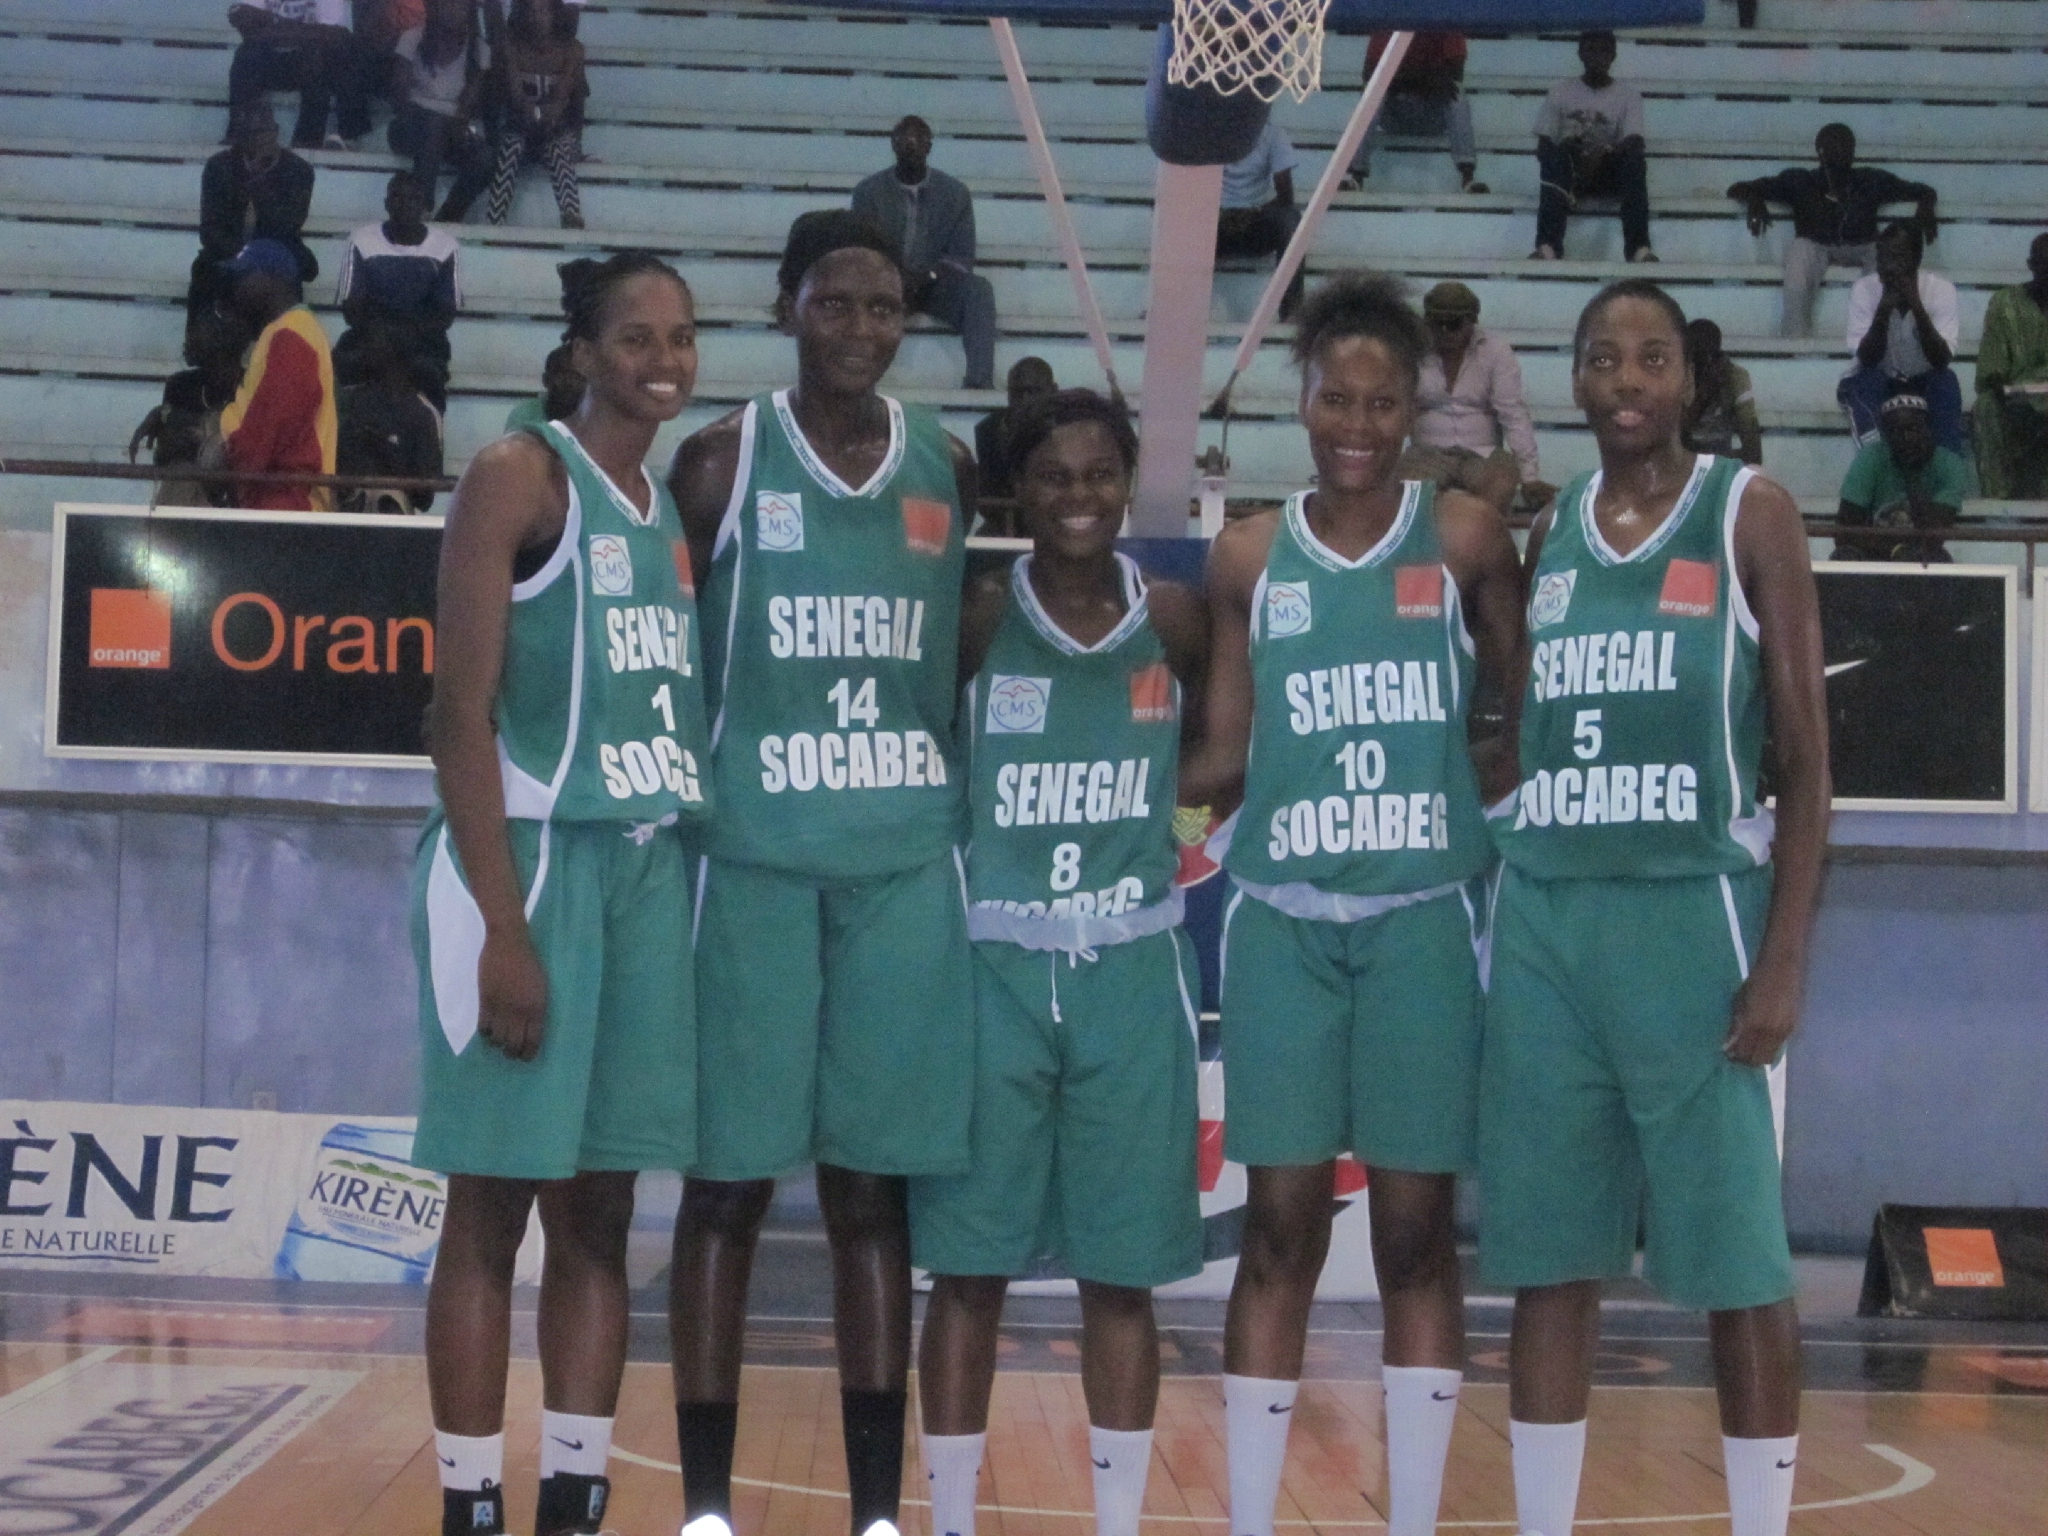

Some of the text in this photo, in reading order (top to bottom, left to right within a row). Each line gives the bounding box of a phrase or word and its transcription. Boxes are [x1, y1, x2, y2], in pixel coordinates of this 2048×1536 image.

[758, 514, 794, 536] CMS
[595, 561, 626, 579] CMS
[769, 595, 925, 661] SENEGAL
[1659, 600, 1711, 615] orange
[93, 647, 162, 665] orange
[606, 605, 693, 677] SENGL
[1533, 630, 1678, 703] SENEGAL
[651, 684, 676, 732] 1
[826, 677, 880, 728] 14
[997, 700, 1036, 717] CMS
[1285, 660, 1447, 735] SENEGAL
[1573, 709, 1602, 760] 5
[1335, 739, 1386, 791] 10
[994, 757, 1151, 828] SENEGAL
[1268, 792, 1449, 861] SOCABEG
[1050, 842, 1082, 891] 8
[309, 1170, 446, 1230] KIRÈNE
[23, 1228, 176, 1255] NATURELLE
[1937, 1270, 1995, 1284] orange
